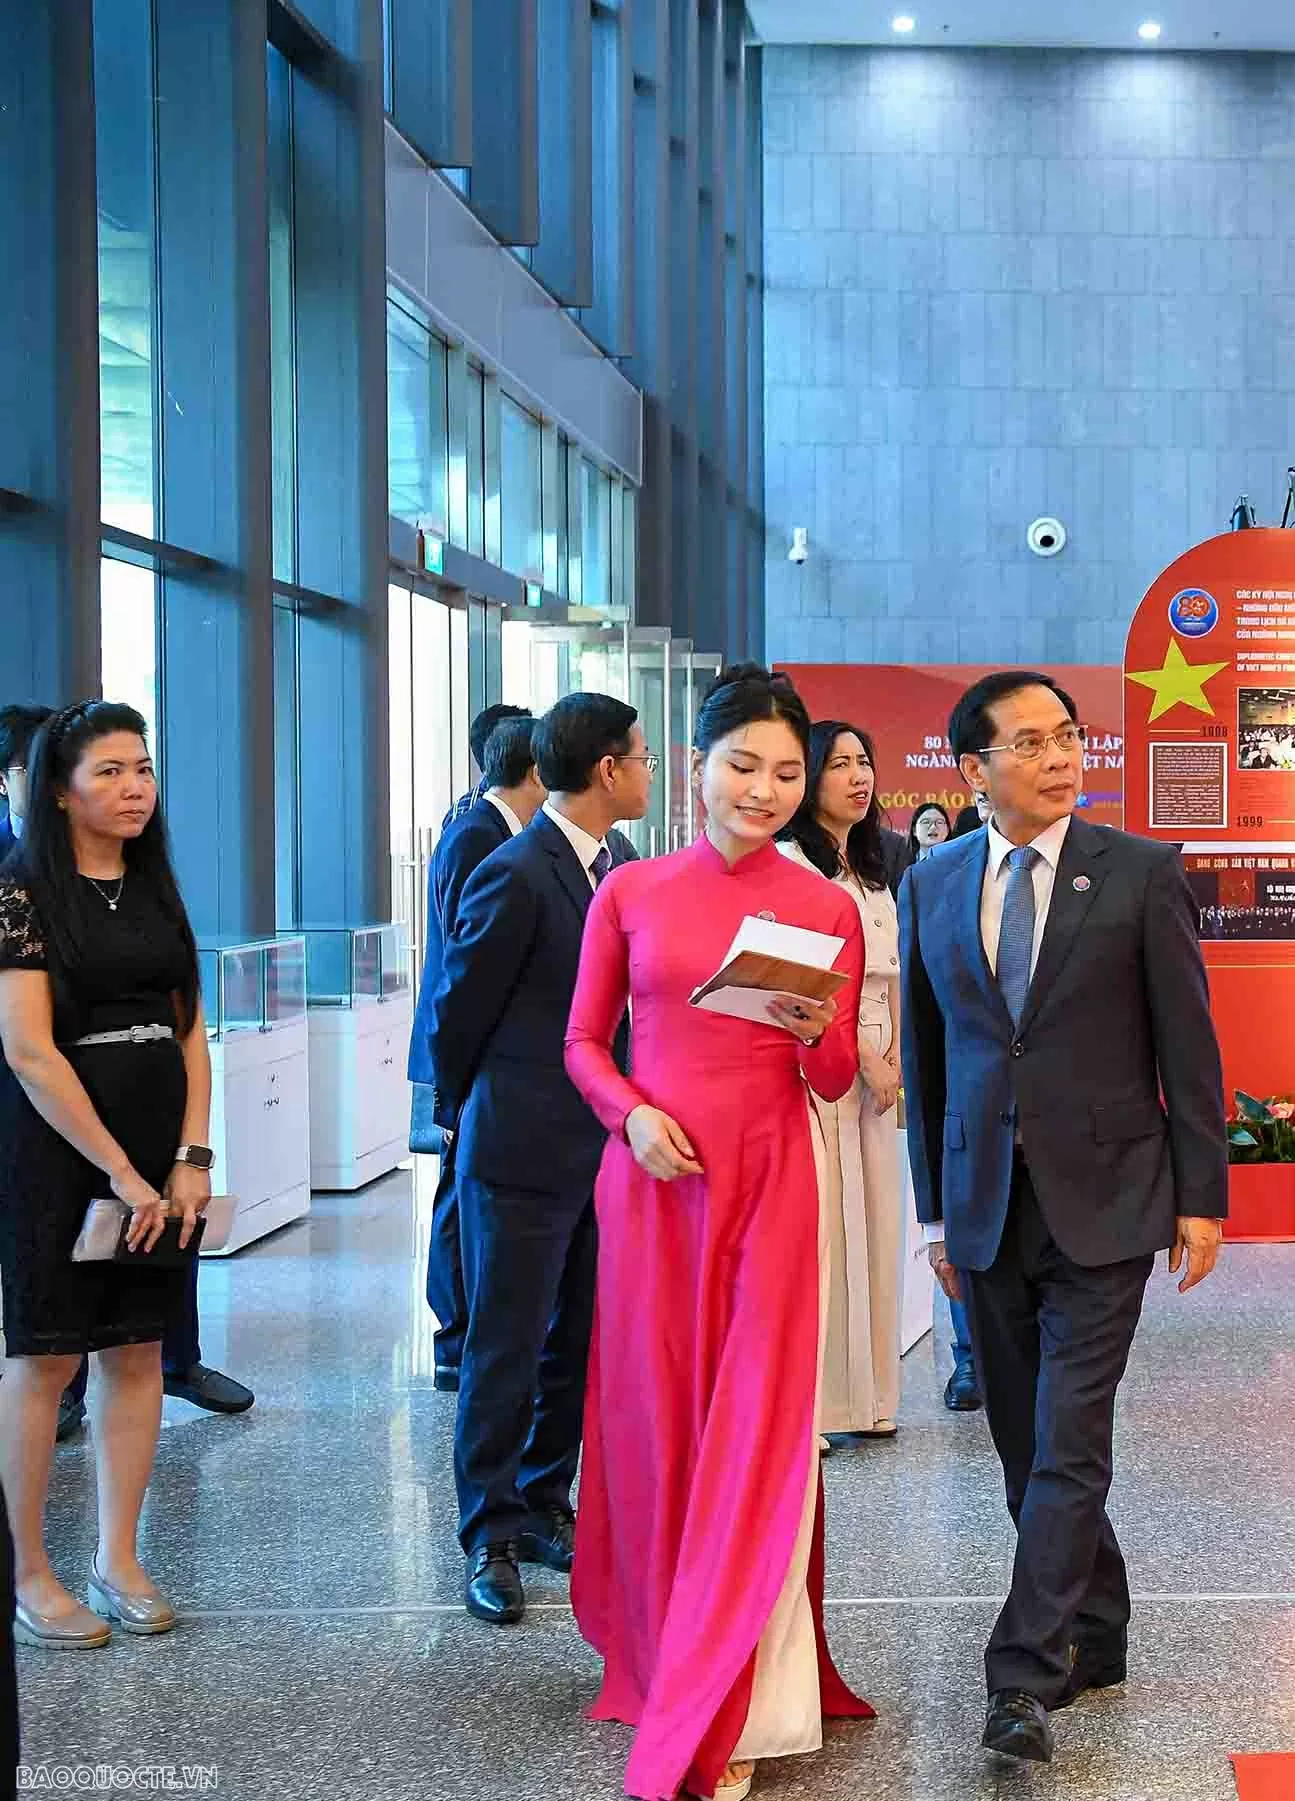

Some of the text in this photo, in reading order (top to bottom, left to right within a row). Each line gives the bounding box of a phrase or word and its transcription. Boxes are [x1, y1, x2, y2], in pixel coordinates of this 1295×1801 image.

[924, 736, 941, 749] 80
[905, 751, 957, 768] NGÀN
[1237, 816, 1263, 828] 1999
